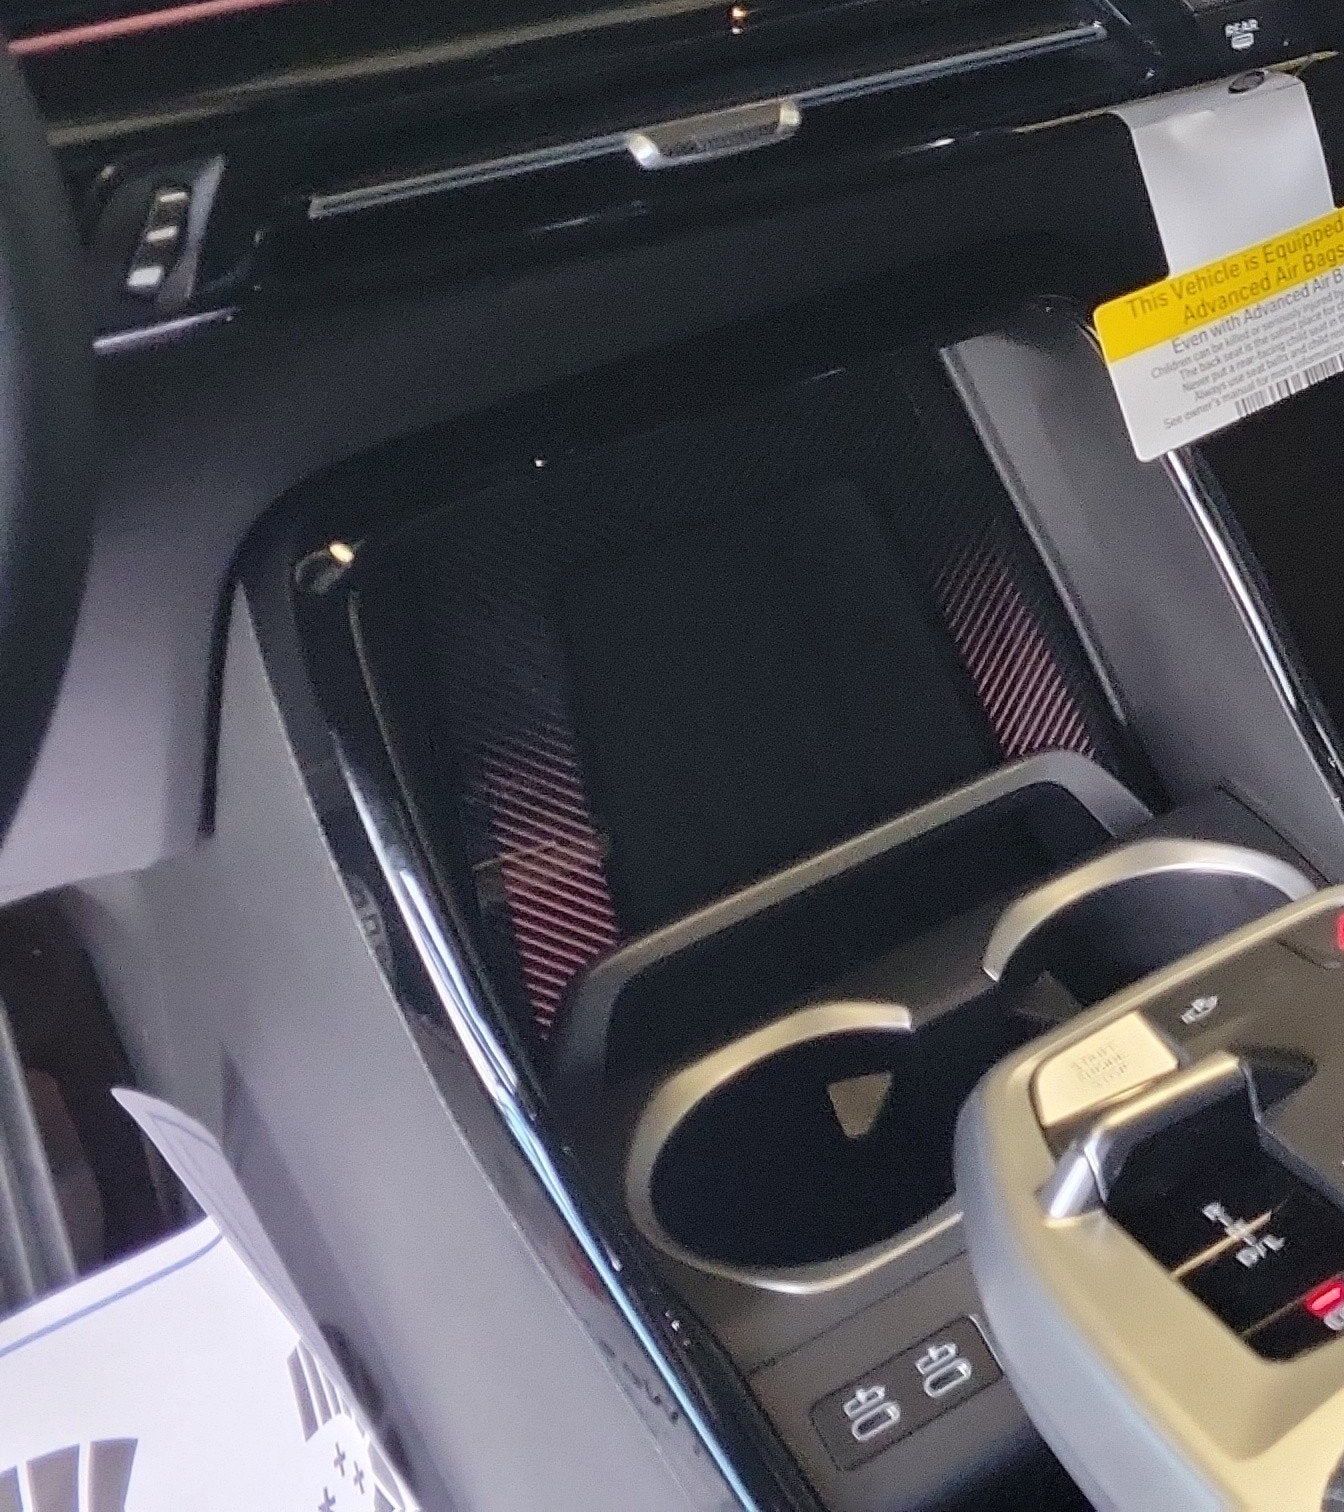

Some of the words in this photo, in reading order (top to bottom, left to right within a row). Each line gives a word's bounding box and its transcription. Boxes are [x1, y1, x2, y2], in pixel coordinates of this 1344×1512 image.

[1125, 290, 1168, 318] This
[1169, 262, 1240, 299] Vehicle
[1243, 254, 1259, 271] is
[1262, 214, 1344, 263] Equipped
[1184, 271, 1271, 323] Advanced
[1275, 262, 1298, 285] Air
[1302, 243, 1344, 273] Bags
[1171, 330, 1208, 354] Even
[1209, 315, 1241, 337] with
[1243, 283, 1310, 323] Advanced
[1312, 275, 1329, 293] Air
